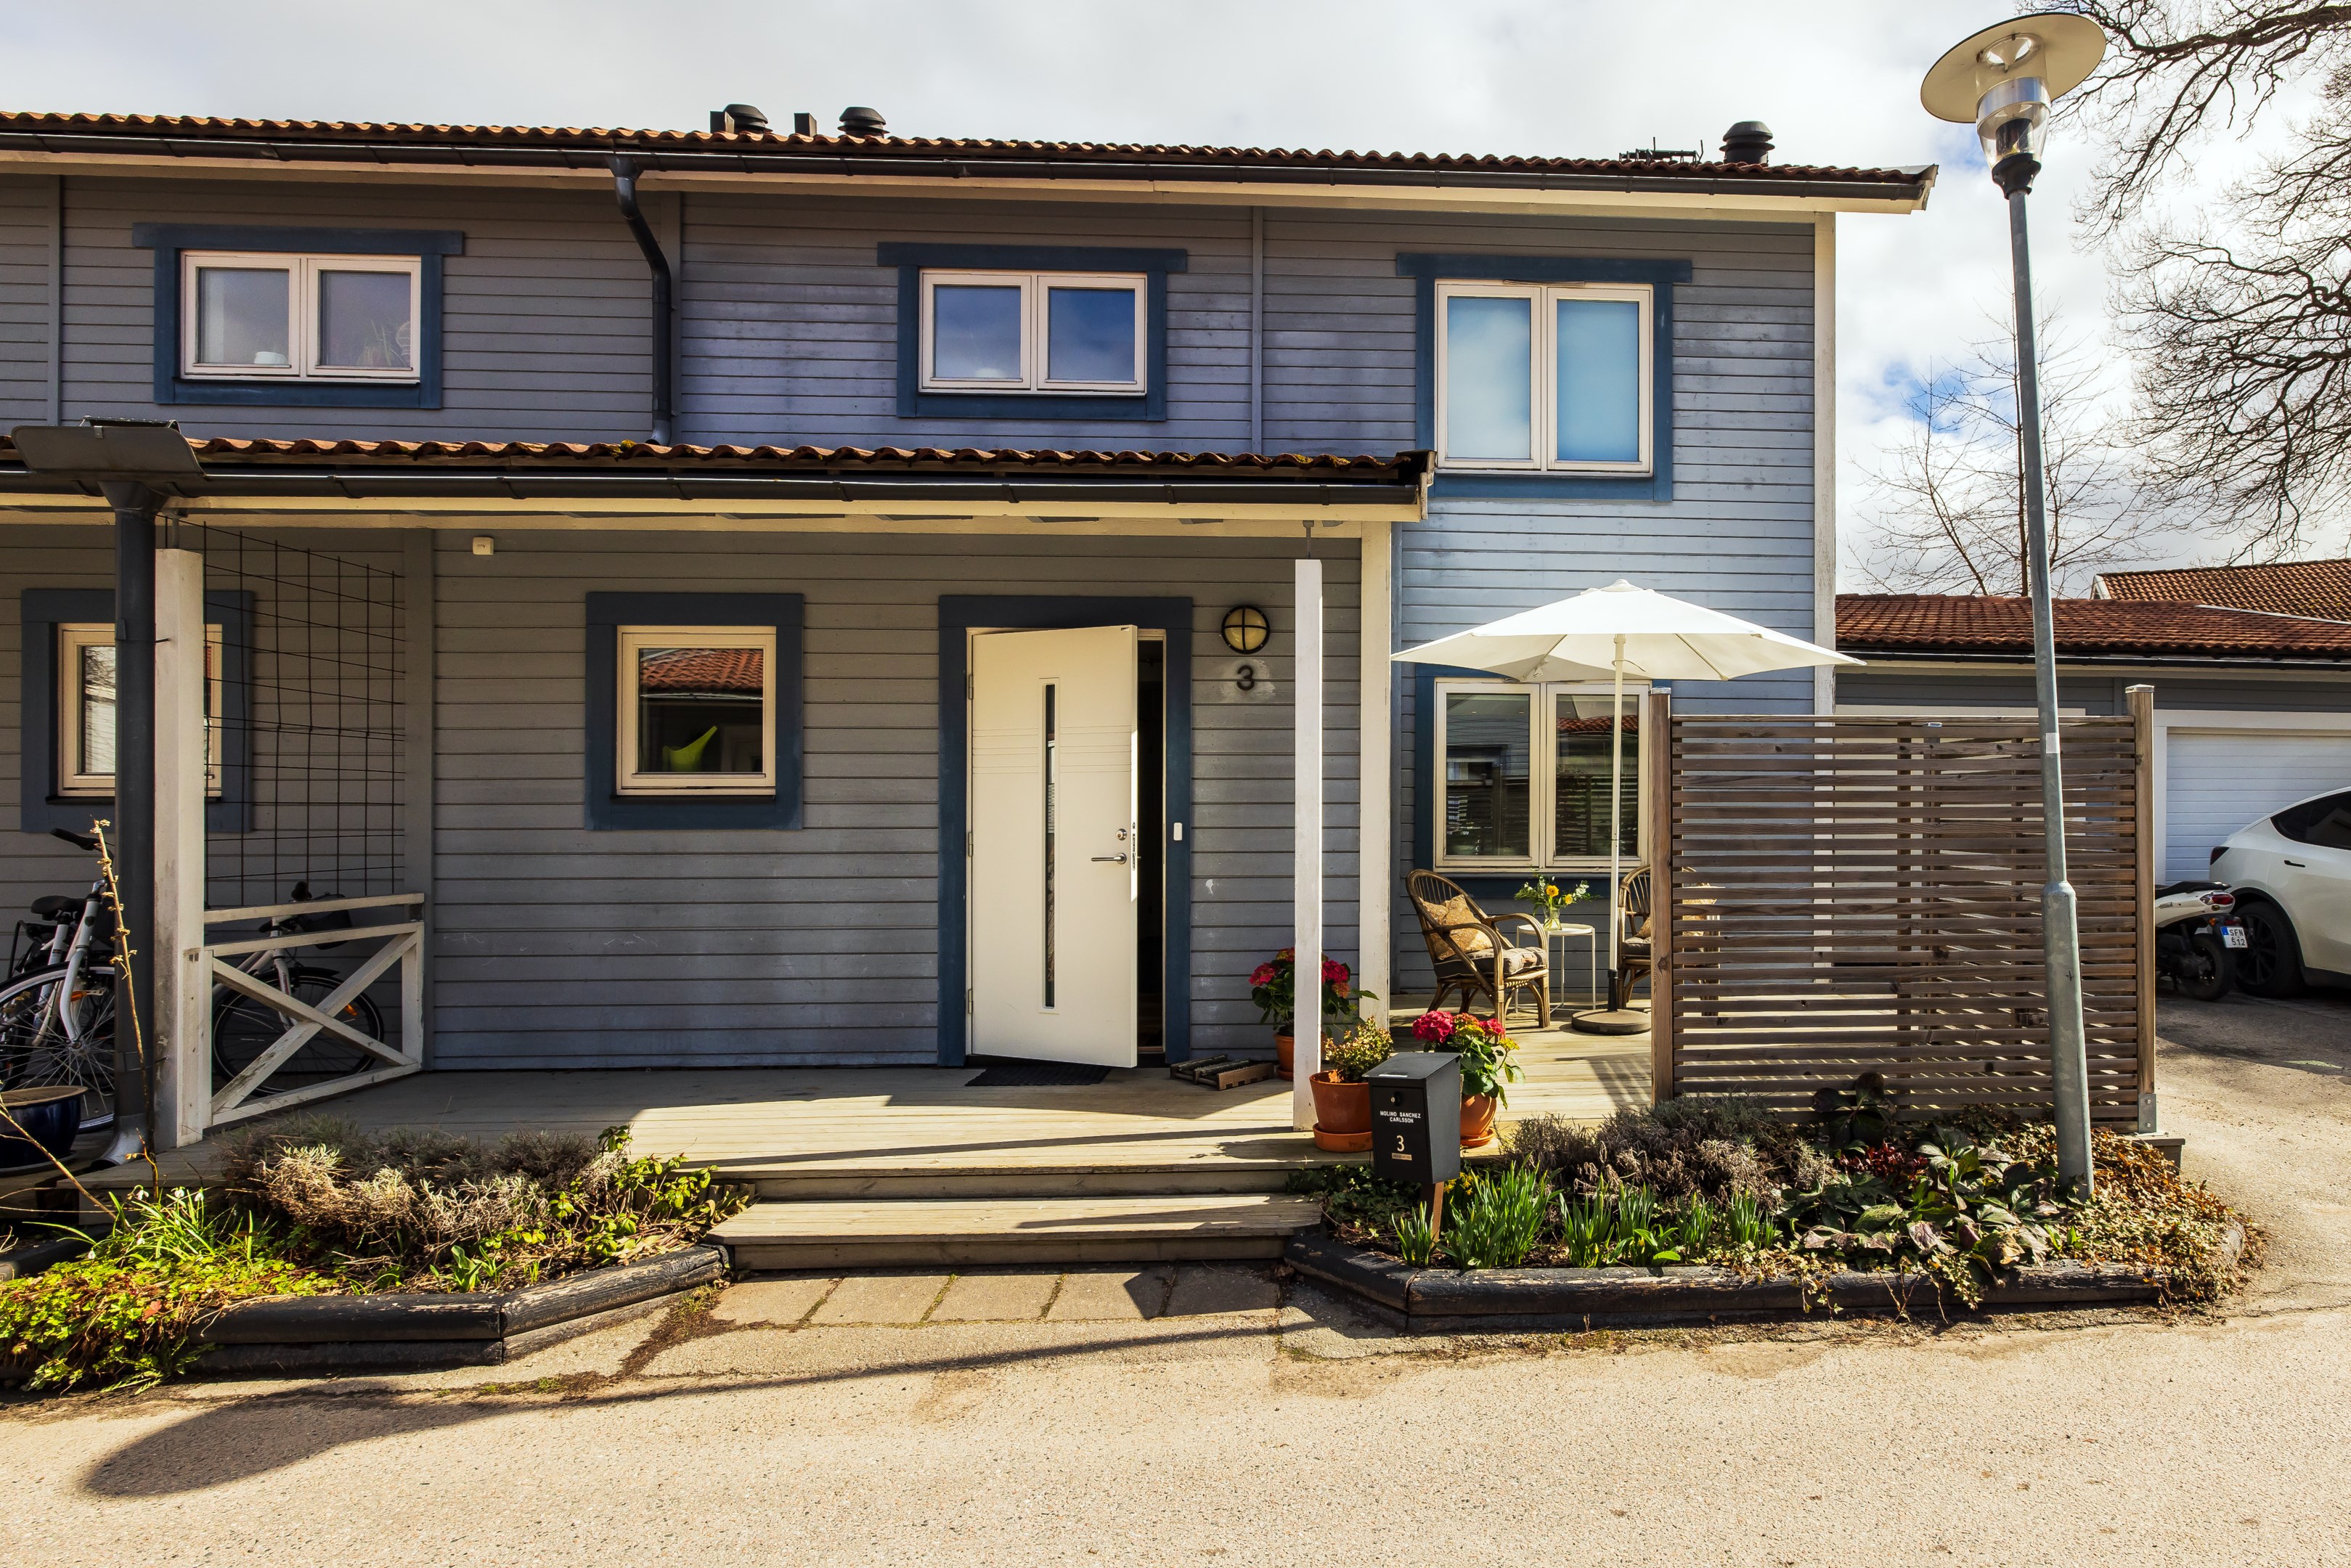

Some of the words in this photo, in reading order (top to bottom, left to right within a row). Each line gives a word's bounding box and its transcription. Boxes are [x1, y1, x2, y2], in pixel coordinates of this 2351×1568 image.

[1236, 665, 1255, 691] 3
[2231, 937, 2246, 946] 512
[1396, 1135, 1405, 1152] 3
